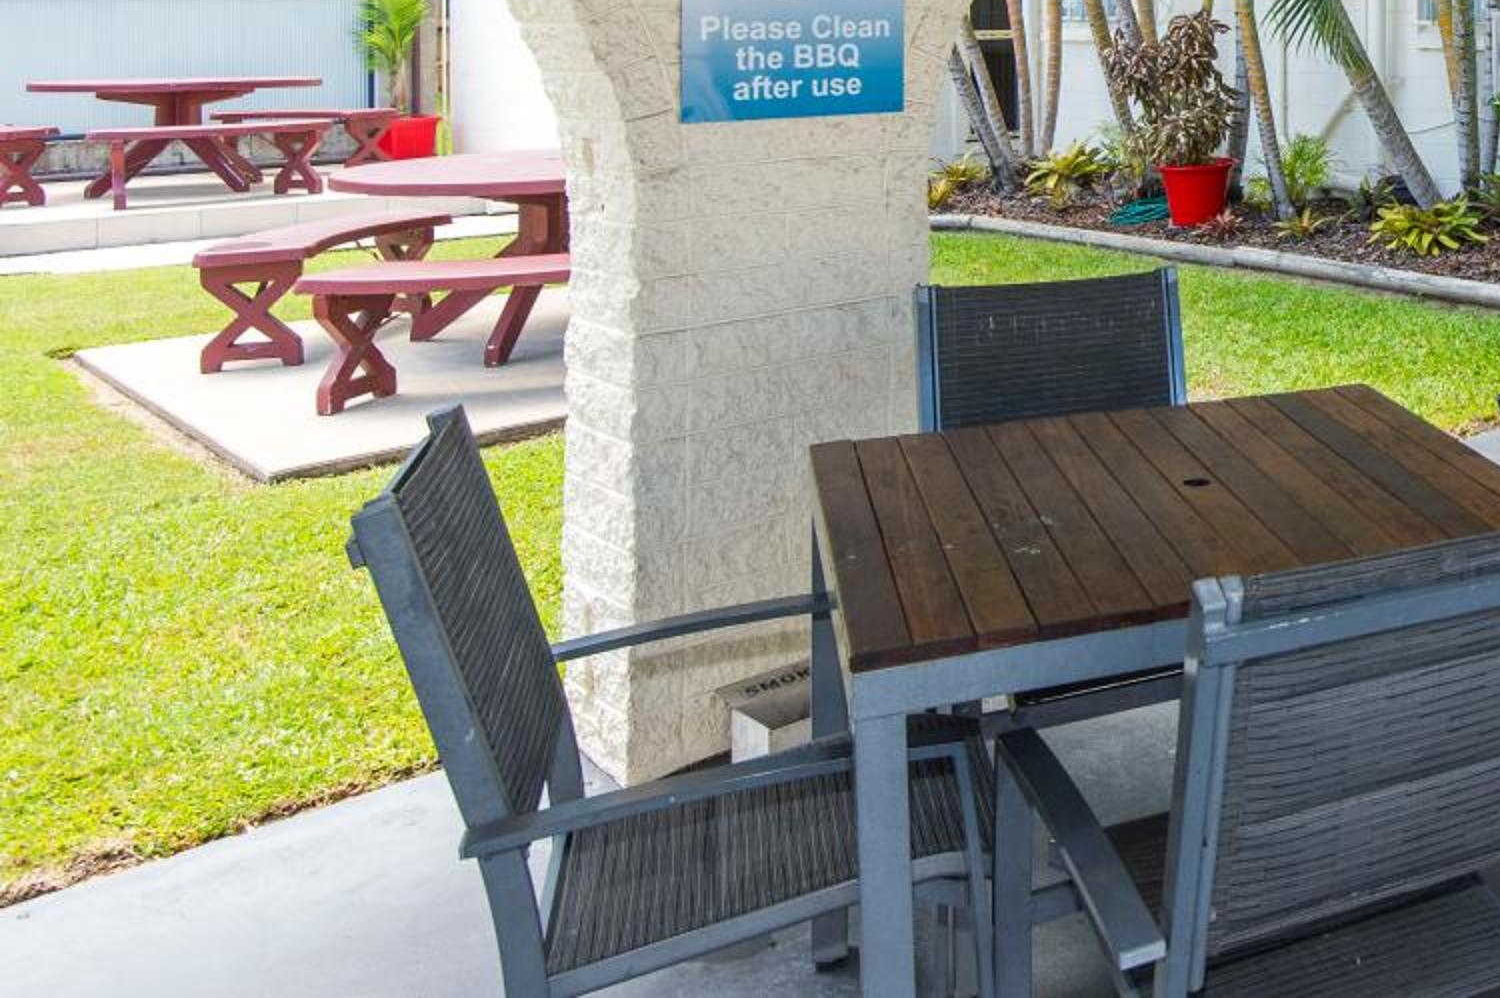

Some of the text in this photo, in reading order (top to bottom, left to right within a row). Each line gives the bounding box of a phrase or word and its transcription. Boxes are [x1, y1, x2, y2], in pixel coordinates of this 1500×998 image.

[700, 14, 890, 41] Please Clean
[735, 43, 860, 71] the BBQ
[733, 75, 862, 101] after use
